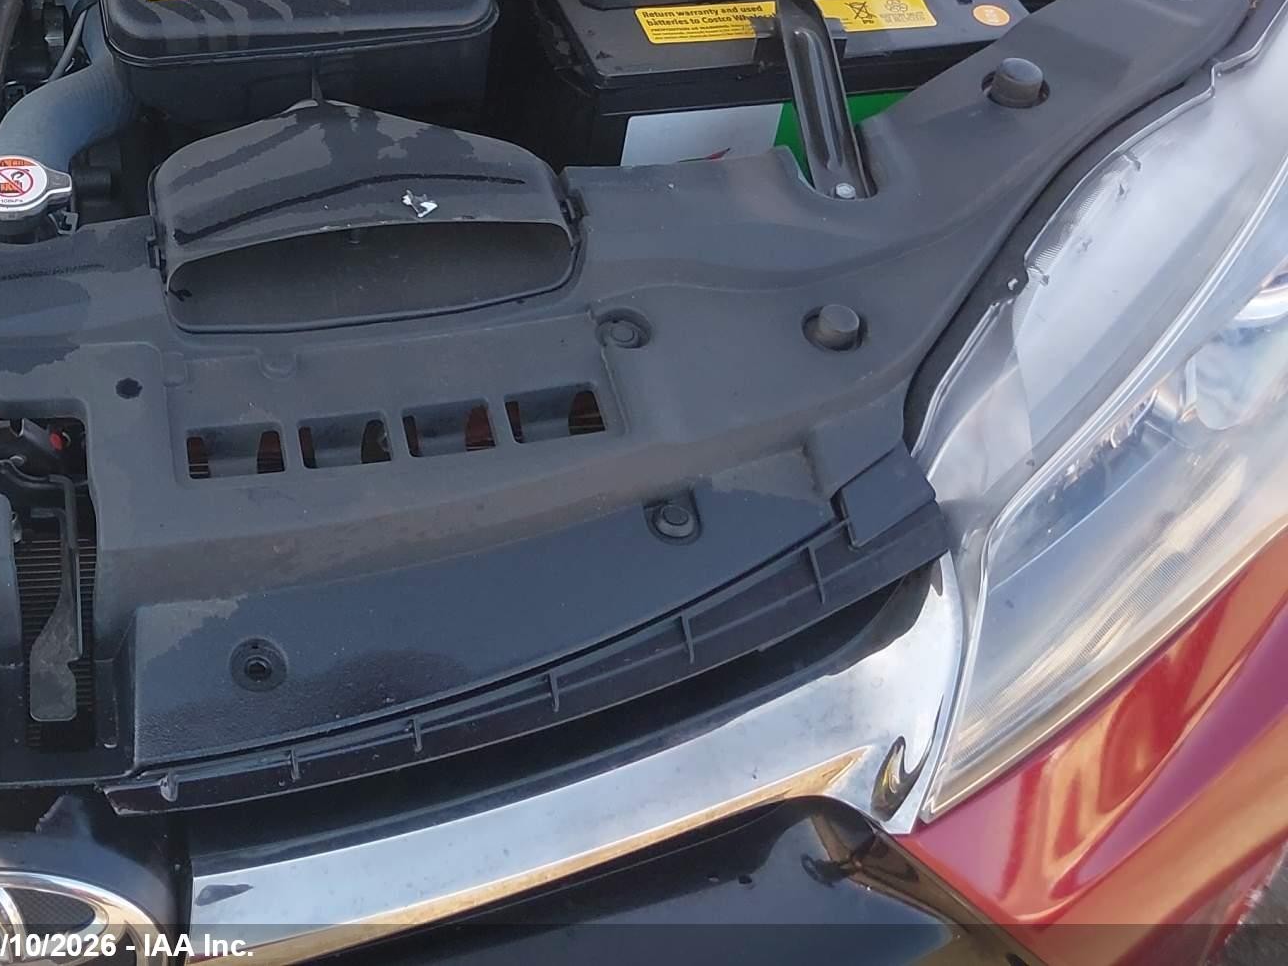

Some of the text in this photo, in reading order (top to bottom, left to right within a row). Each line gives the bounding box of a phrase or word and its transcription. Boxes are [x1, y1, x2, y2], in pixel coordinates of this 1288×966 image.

[643, 5, 763, 18] Return warranty and used
[646, 18, 689, 27] batteries
[691, 17, 700, 25] to
[702, 15, 732, 24] Costco
